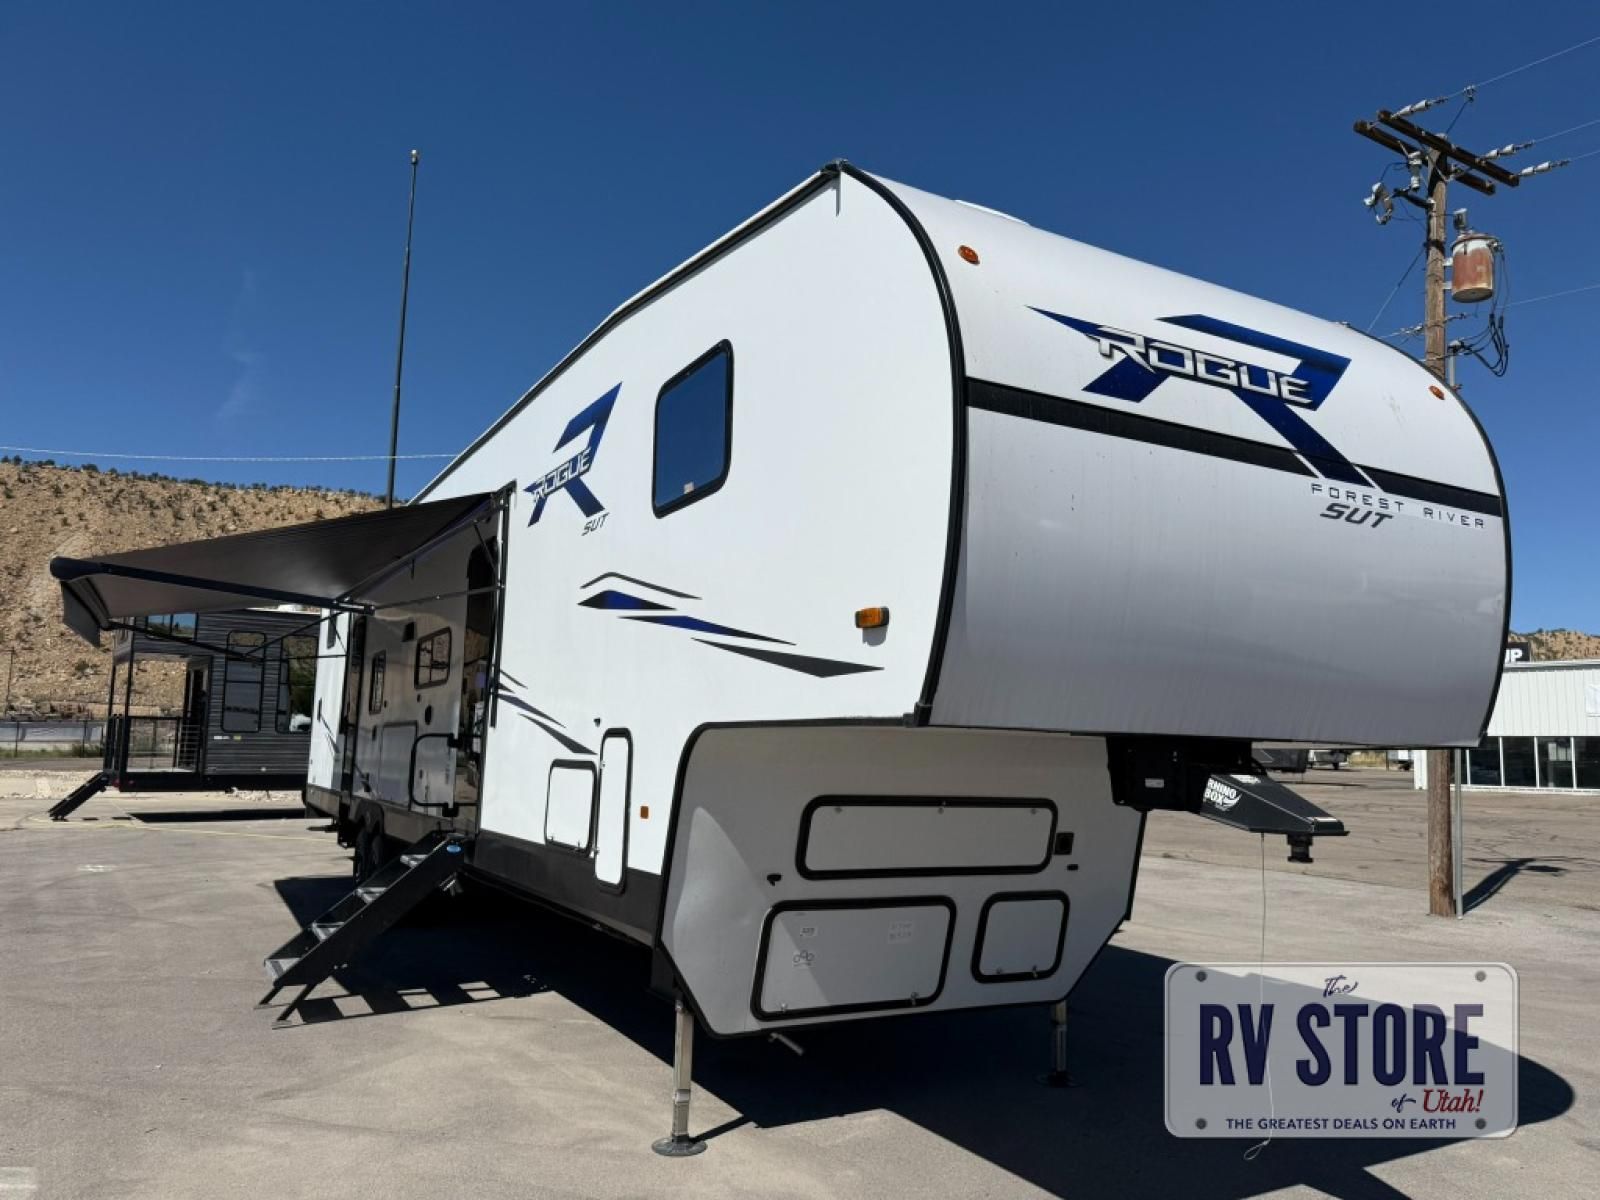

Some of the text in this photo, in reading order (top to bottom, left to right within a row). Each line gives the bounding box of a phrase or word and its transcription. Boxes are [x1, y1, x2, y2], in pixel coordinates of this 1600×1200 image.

[1088, 325, 1312, 405] ROGUE
[532, 447, 592, 503] ROGUE
[1311, 482, 1486, 530] FOREST RIVER
[1320, 503, 1393, 529] SUT
[581, 511, 610, 537] SUT
[1204, 788, 1225, 805] BOX
[1207, 778, 1237, 799] RHINO
